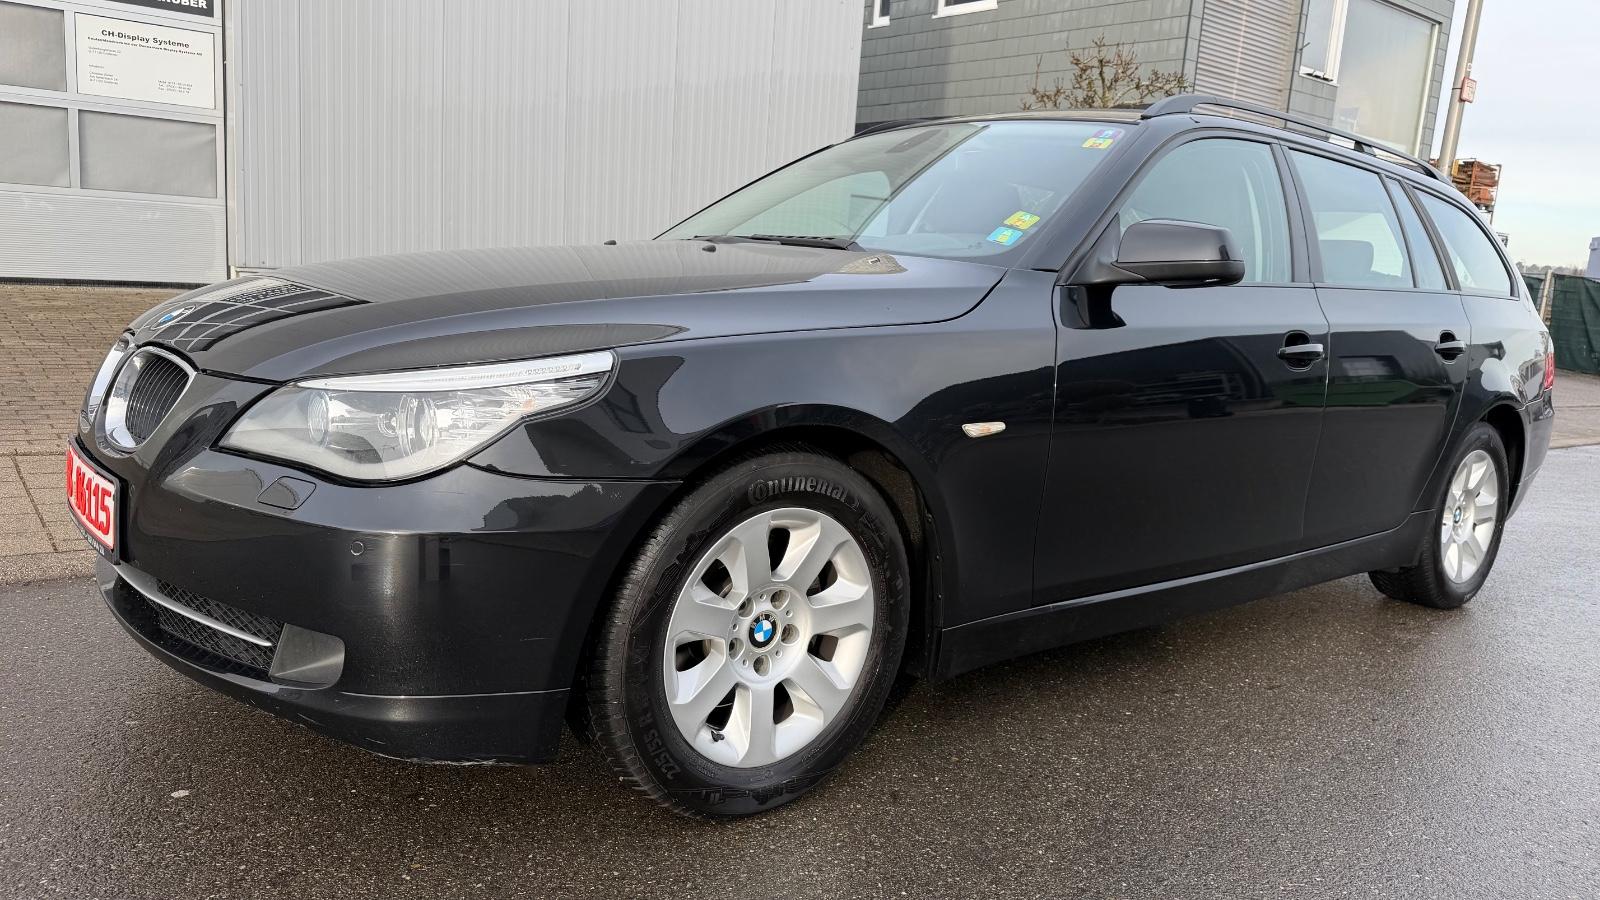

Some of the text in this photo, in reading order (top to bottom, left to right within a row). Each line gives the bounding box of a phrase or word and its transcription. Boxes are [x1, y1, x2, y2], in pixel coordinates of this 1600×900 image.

[101, 29, 151, 44] CH-Display
[152, 37, 190, 49] Systeme
[747, 475, 849, 505] Continental
